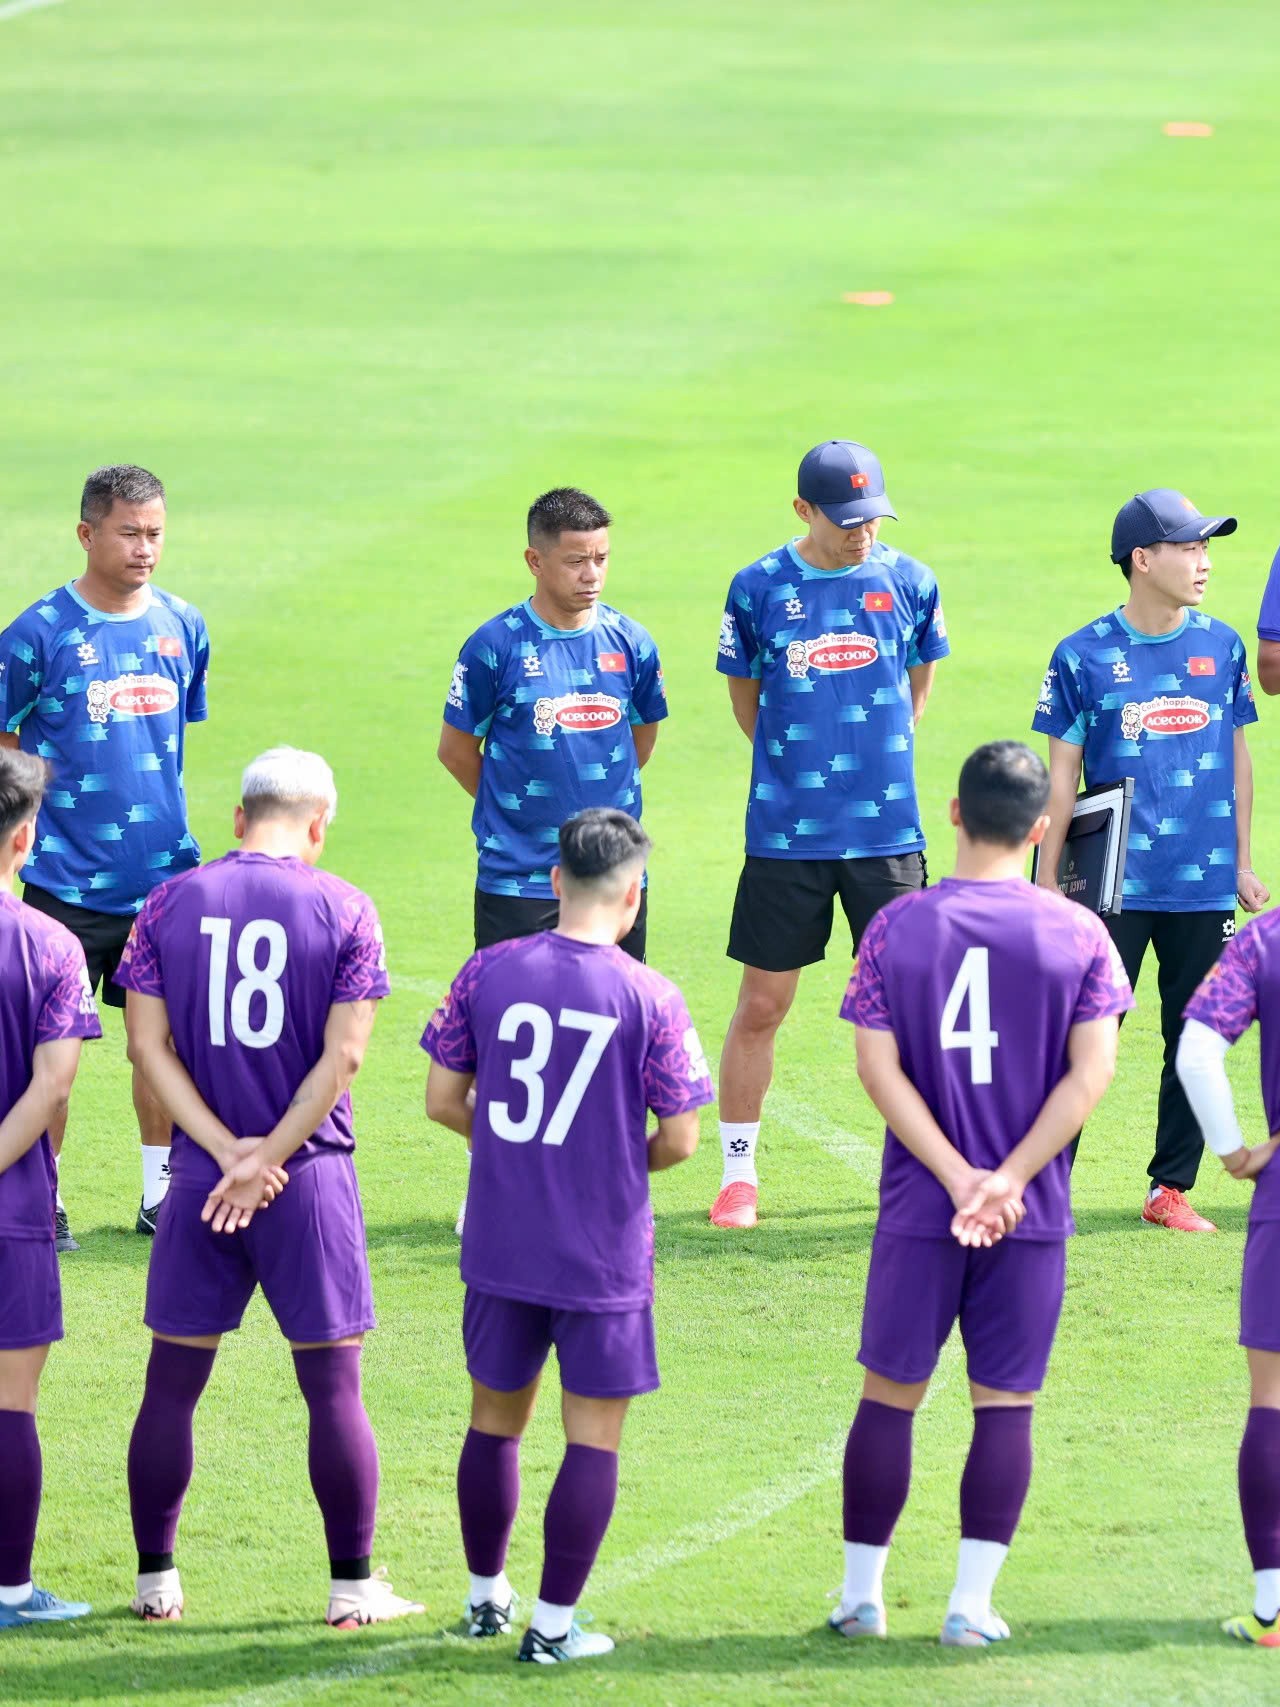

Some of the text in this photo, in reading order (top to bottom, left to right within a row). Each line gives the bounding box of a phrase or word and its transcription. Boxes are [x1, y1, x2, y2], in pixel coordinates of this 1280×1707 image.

[200, 916, 288, 1049] 18
[940, 947, 998, 1085] 4
[488, 1002, 620, 1147] 37
